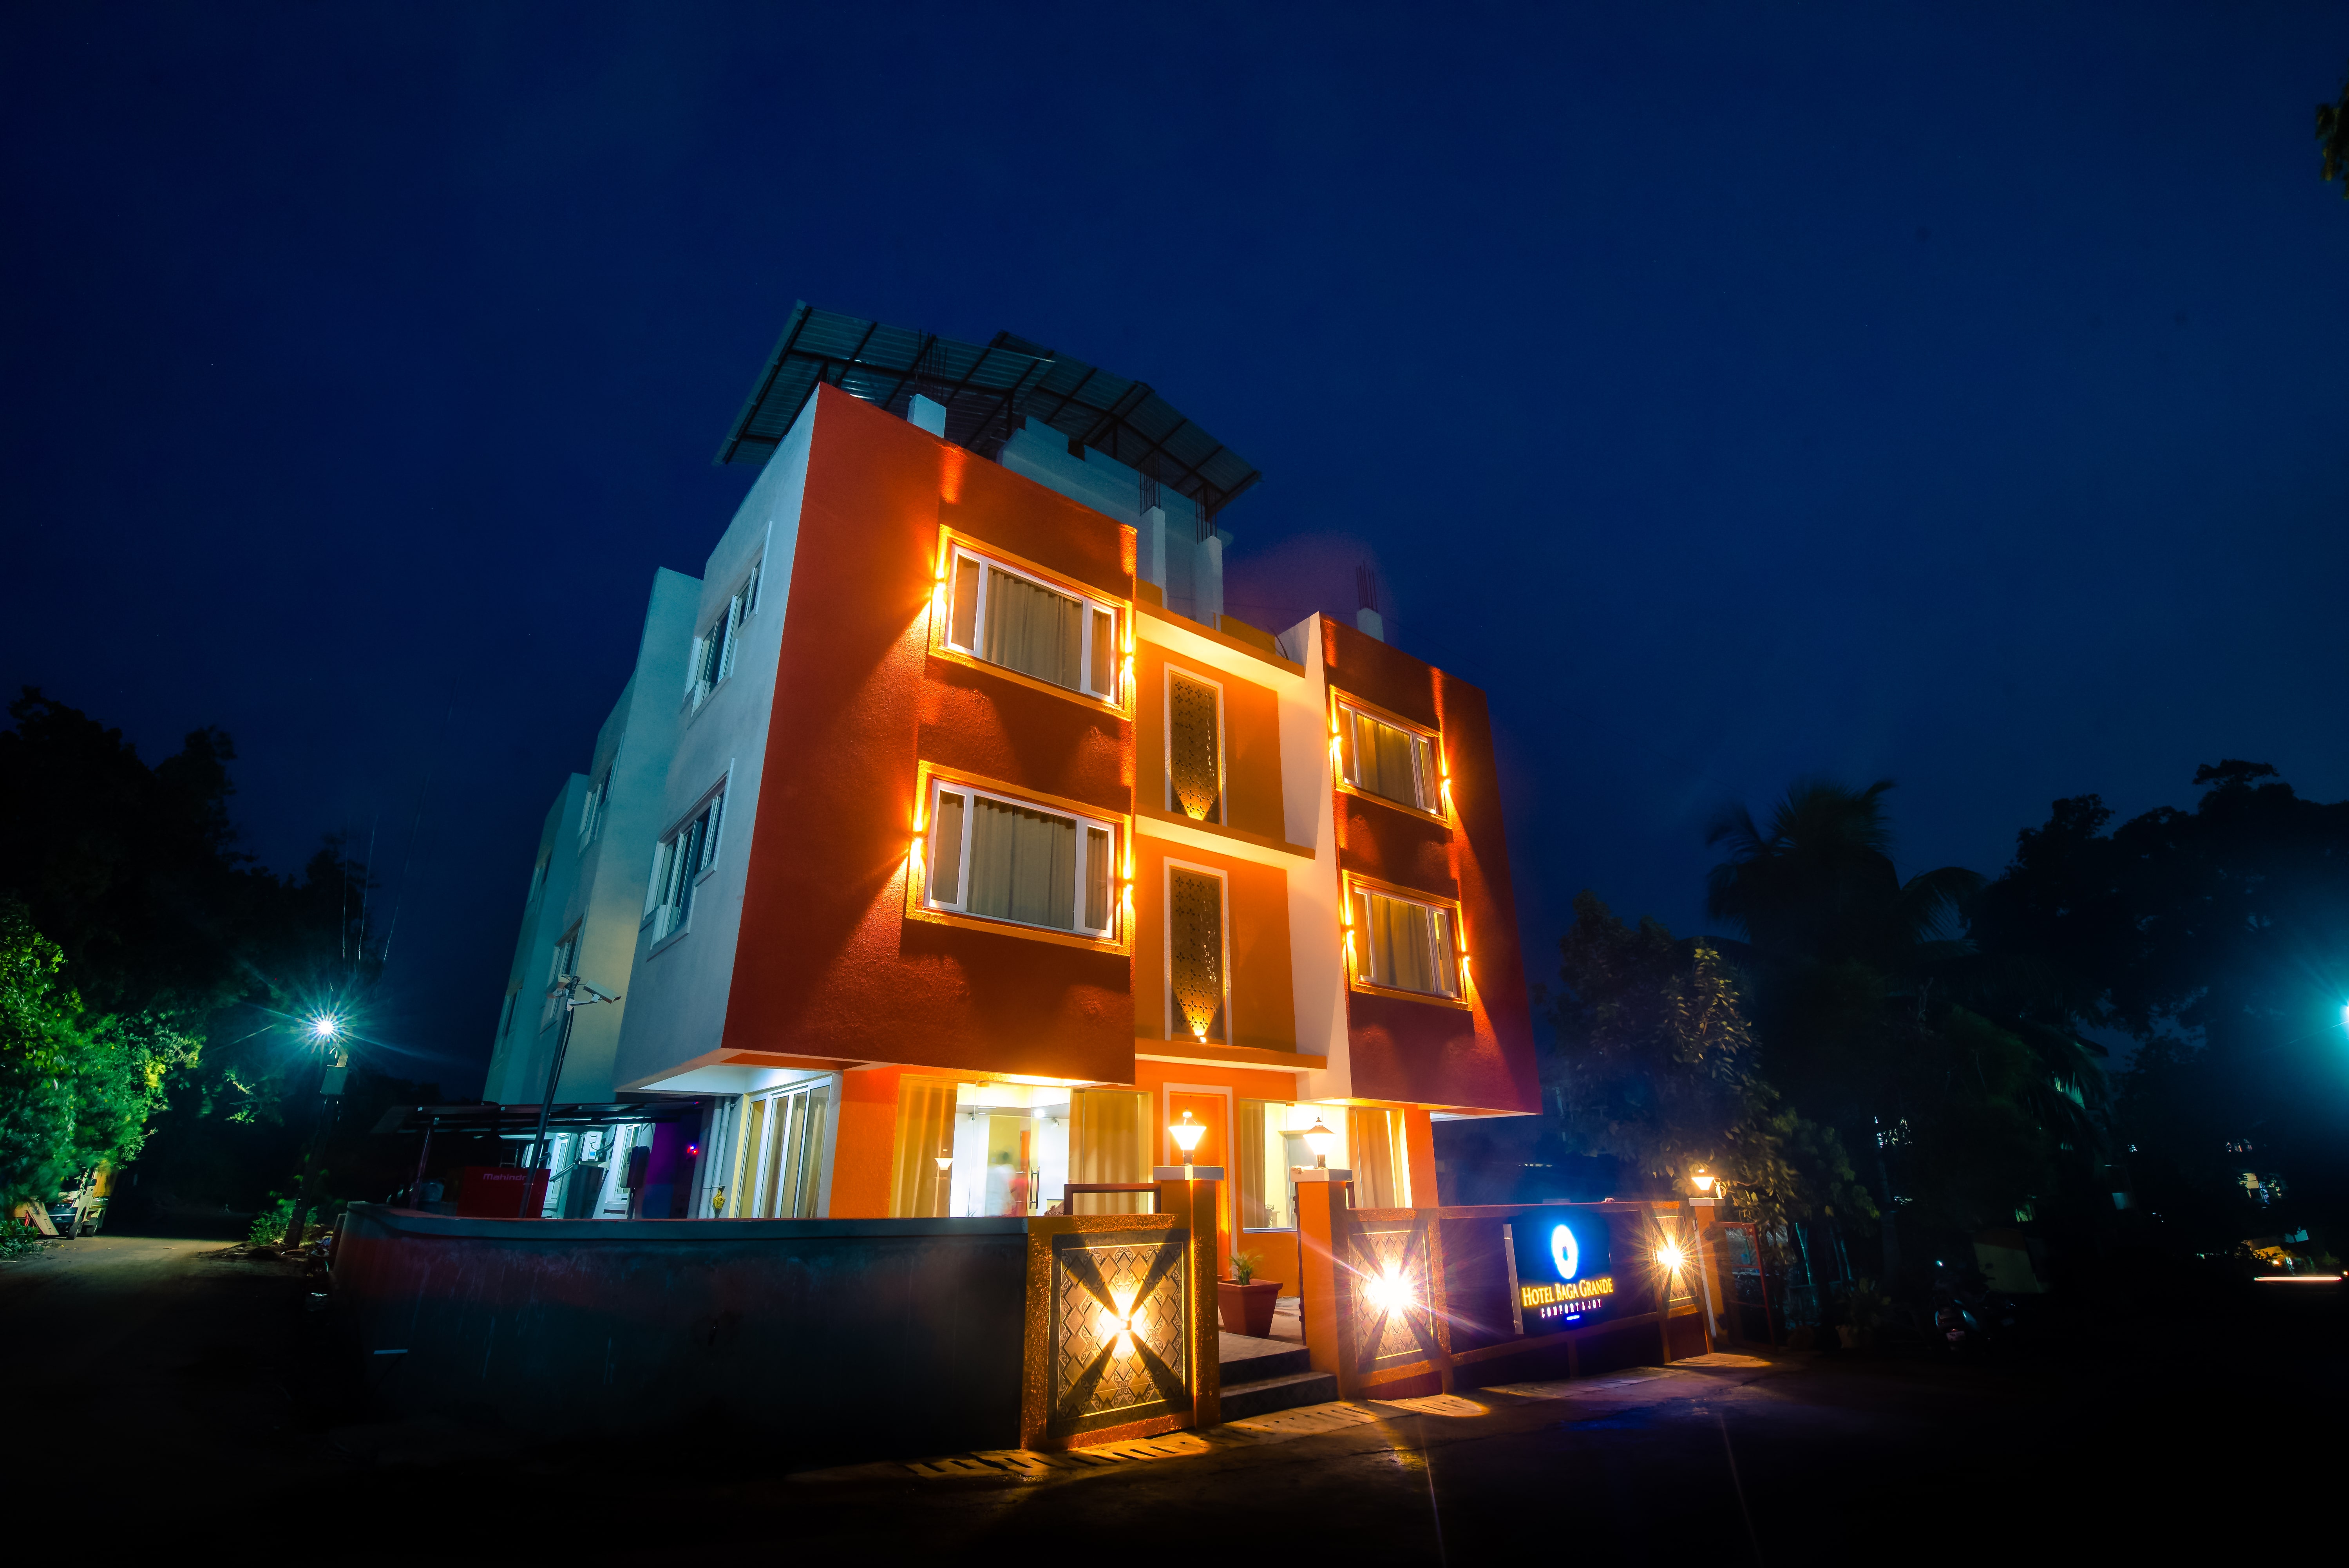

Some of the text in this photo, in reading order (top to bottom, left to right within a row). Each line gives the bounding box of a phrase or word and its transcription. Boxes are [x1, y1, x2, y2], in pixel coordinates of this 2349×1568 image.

[1522, 1278, 1613, 1306] HOTEL BAGA GRANDE
[1541, 1302, 1579, 1318] COMFORT
[1588, 1299, 1601, 1310] JOY
